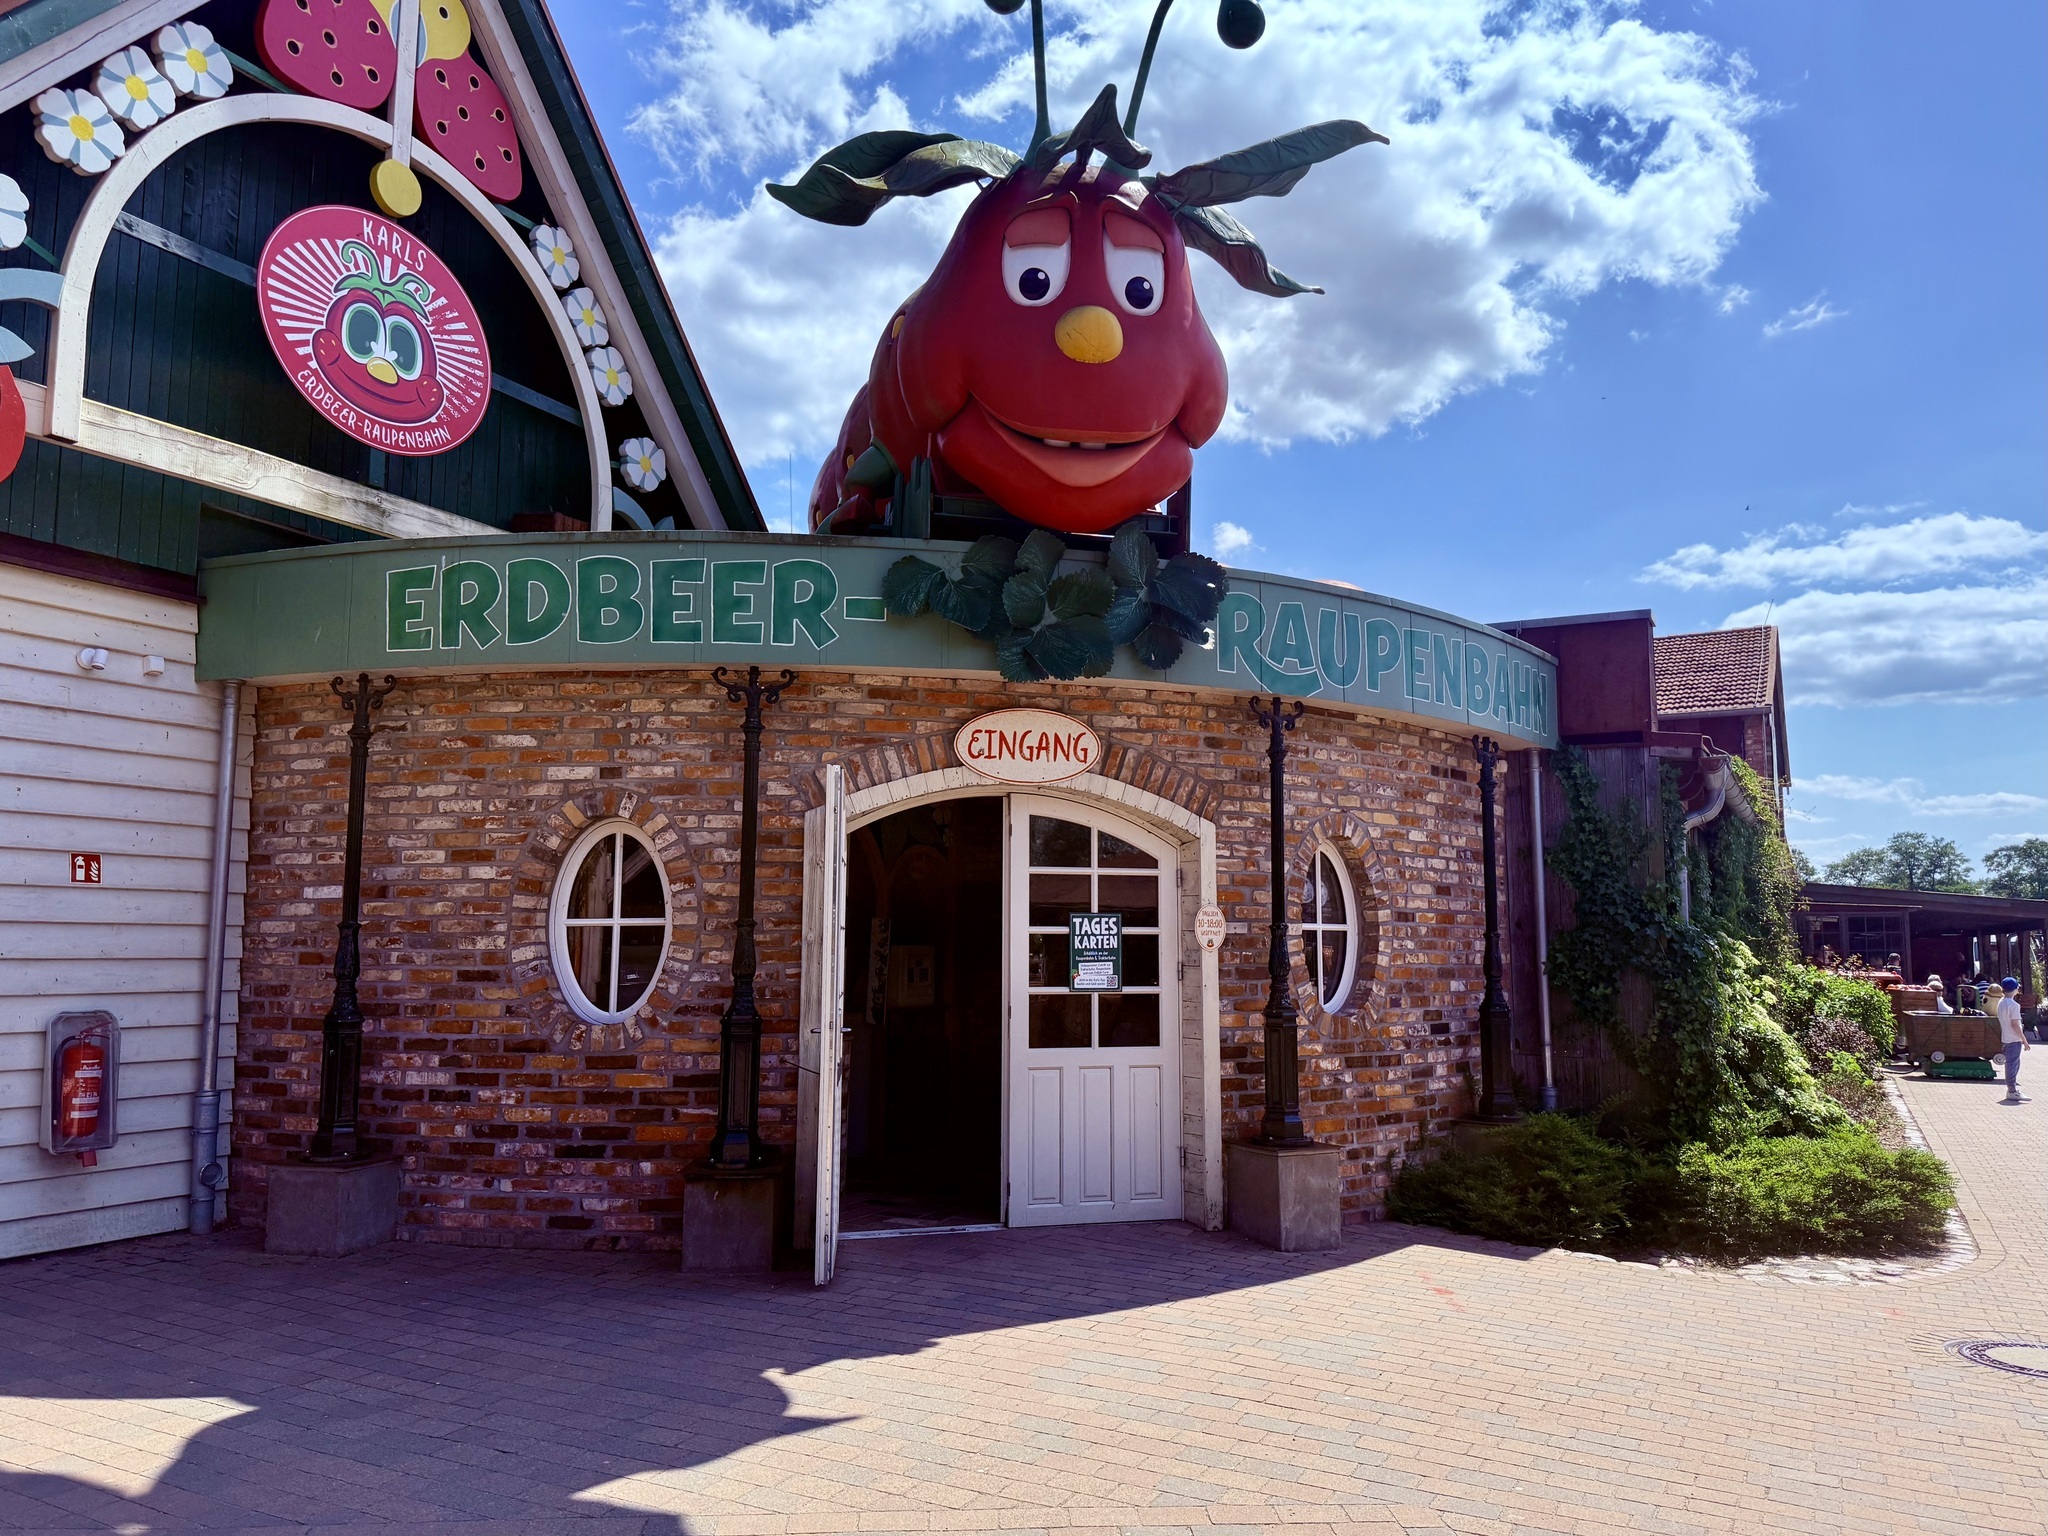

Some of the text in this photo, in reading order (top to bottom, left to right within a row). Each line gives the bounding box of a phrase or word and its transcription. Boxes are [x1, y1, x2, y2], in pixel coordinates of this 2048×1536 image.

[362, 217, 427, 273] KARLS
[297, 368, 452, 449] ERDBEER-RAUPENBAHN
[386, 555, 1548, 737] ERDBEER- RAUPENBAHN
[967, 729, 1088, 764] EINGANG
[1073, 917, 1118, 935] TAGES
[1074, 935, 1118, 949] KARTEN
